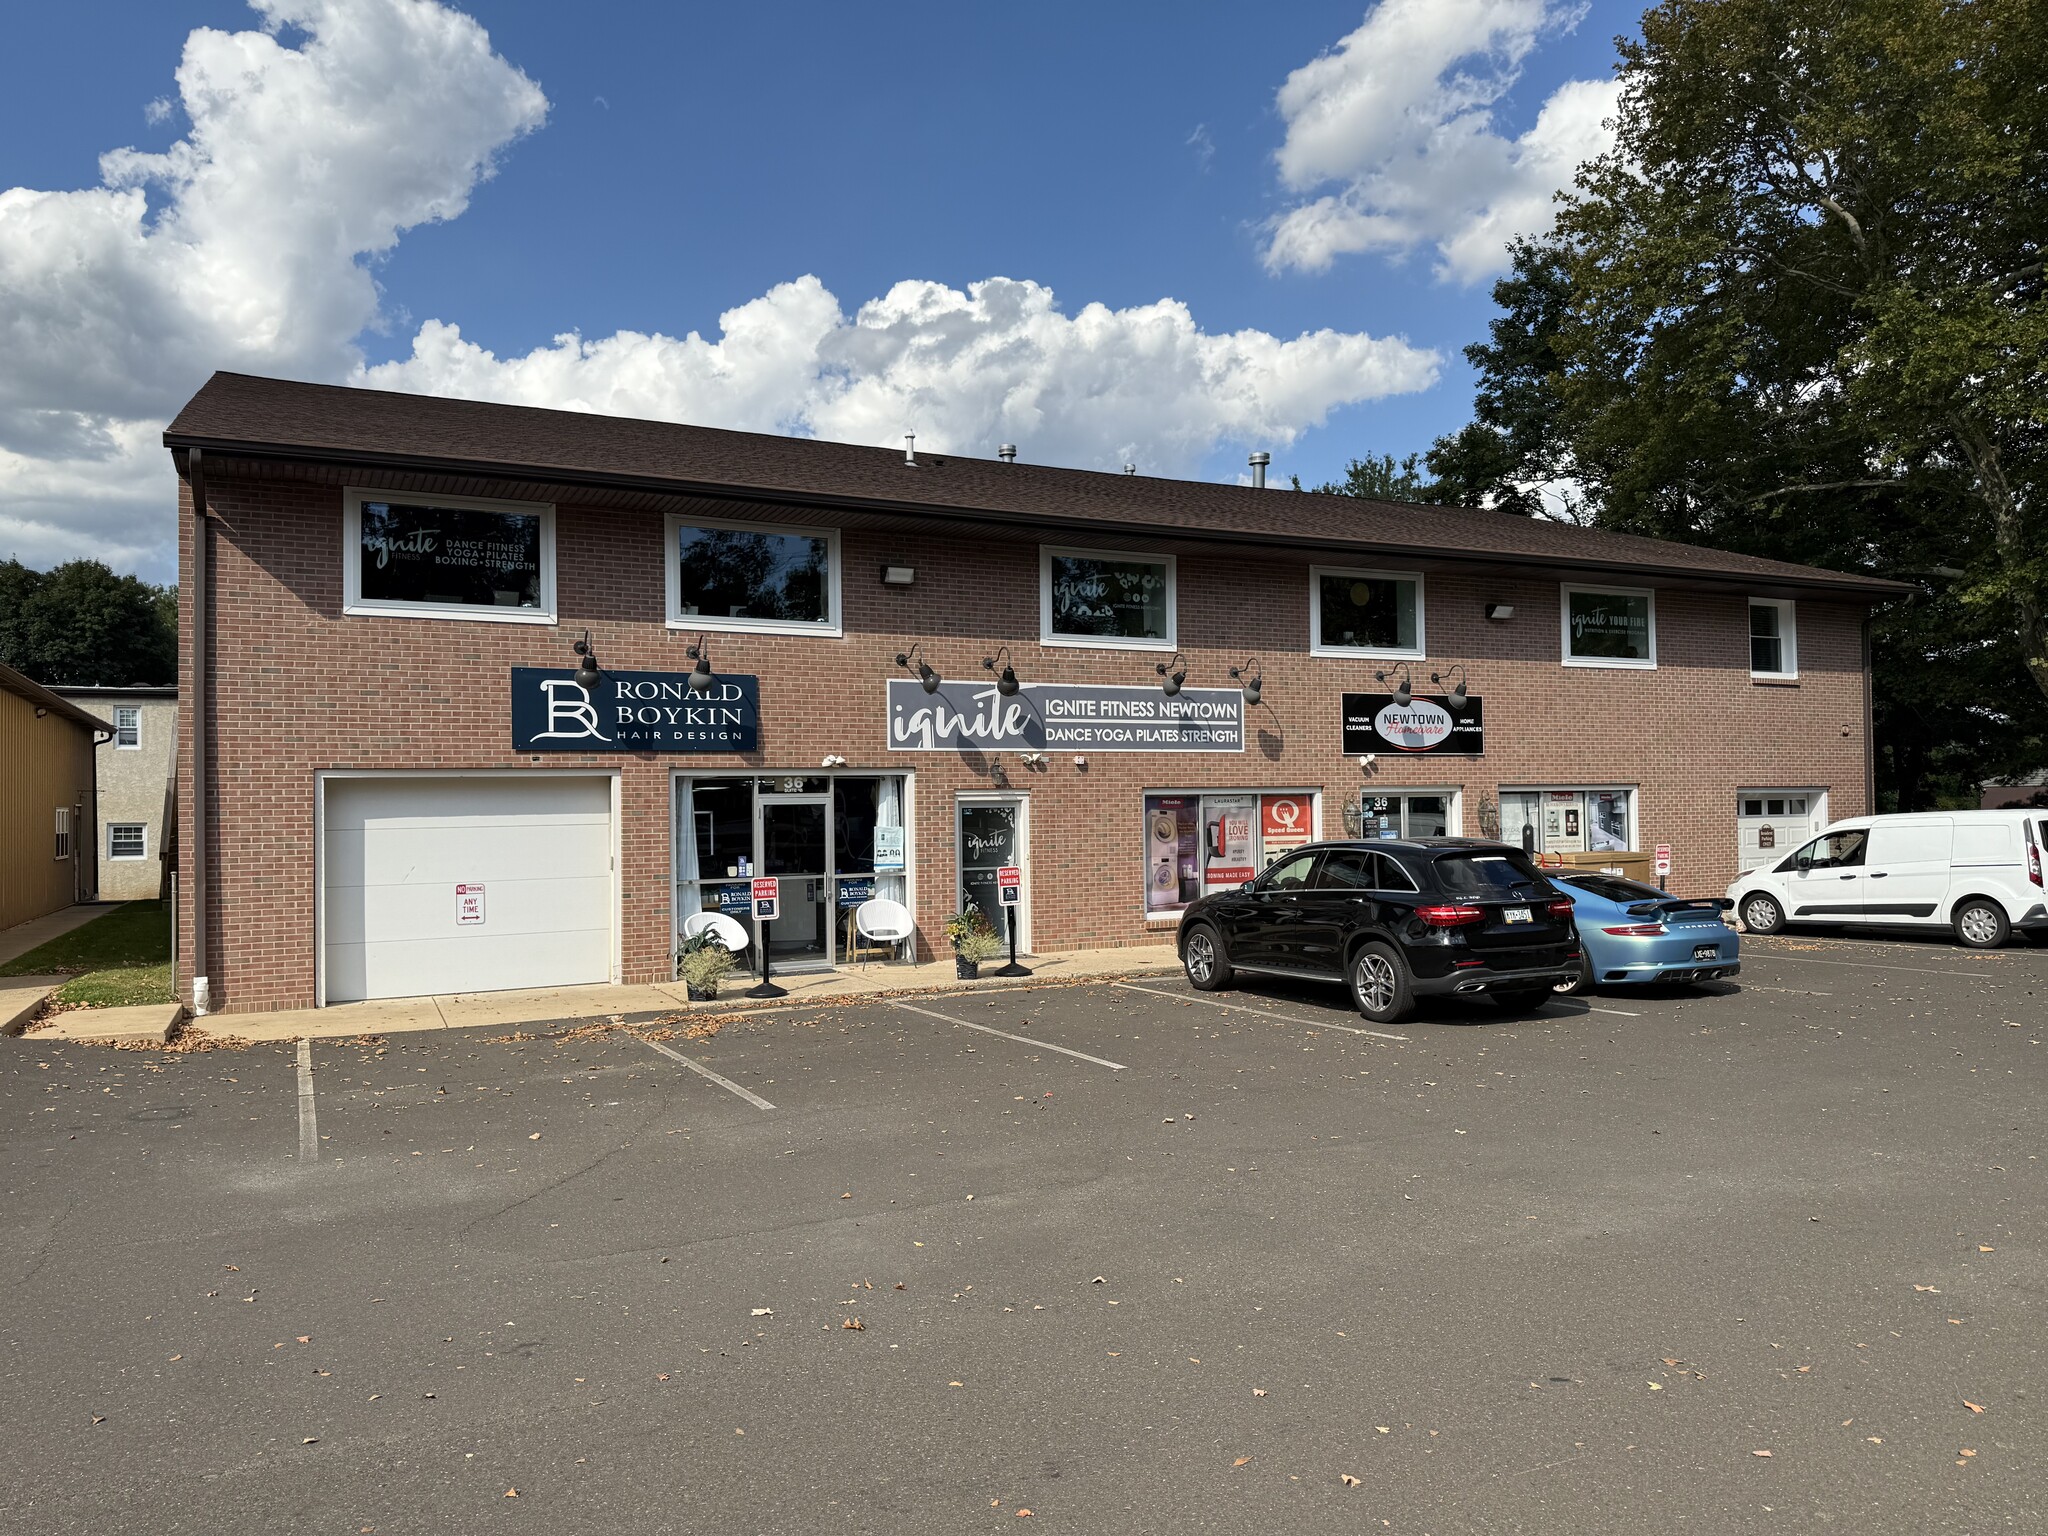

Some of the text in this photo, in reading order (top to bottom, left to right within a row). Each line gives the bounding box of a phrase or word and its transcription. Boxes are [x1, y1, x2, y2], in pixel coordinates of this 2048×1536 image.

[446, 540, 525, 553] DANCE FITNESS
[392, 552, 420, 560] FITNESS
[447, 548, 524, 562] YOGA PILATES
[435, 556, 536, 571] BOXING STRENGTH
[1054, 568, 1112, 613] ignite
[1572, 606, 1646, 638] ignite YOUR FIRE
[615, 681, 743, 702] RONALD
[616, 706, 743, 726] BOYKIN
[894, 684, 1037, 748] ignite
[1046, 700, 1237, 718] IGNITE FITNESS NEWTOWN
[1384, 714, 1444, 724] NEWTOWN
[1046, 728, 1238, 742] DANCE YOGA PILATES STRENGTH
[1385, 720, 1444, 736] Homeware
[617, 731, 742, 740] HAIR DESIGN
[784, 776, 804, 788] 36
[1374, 797, 1388, 807] 36
[1229, 826, 1248, 835] LOVE
[968, 829, 1008, 860] ignite
